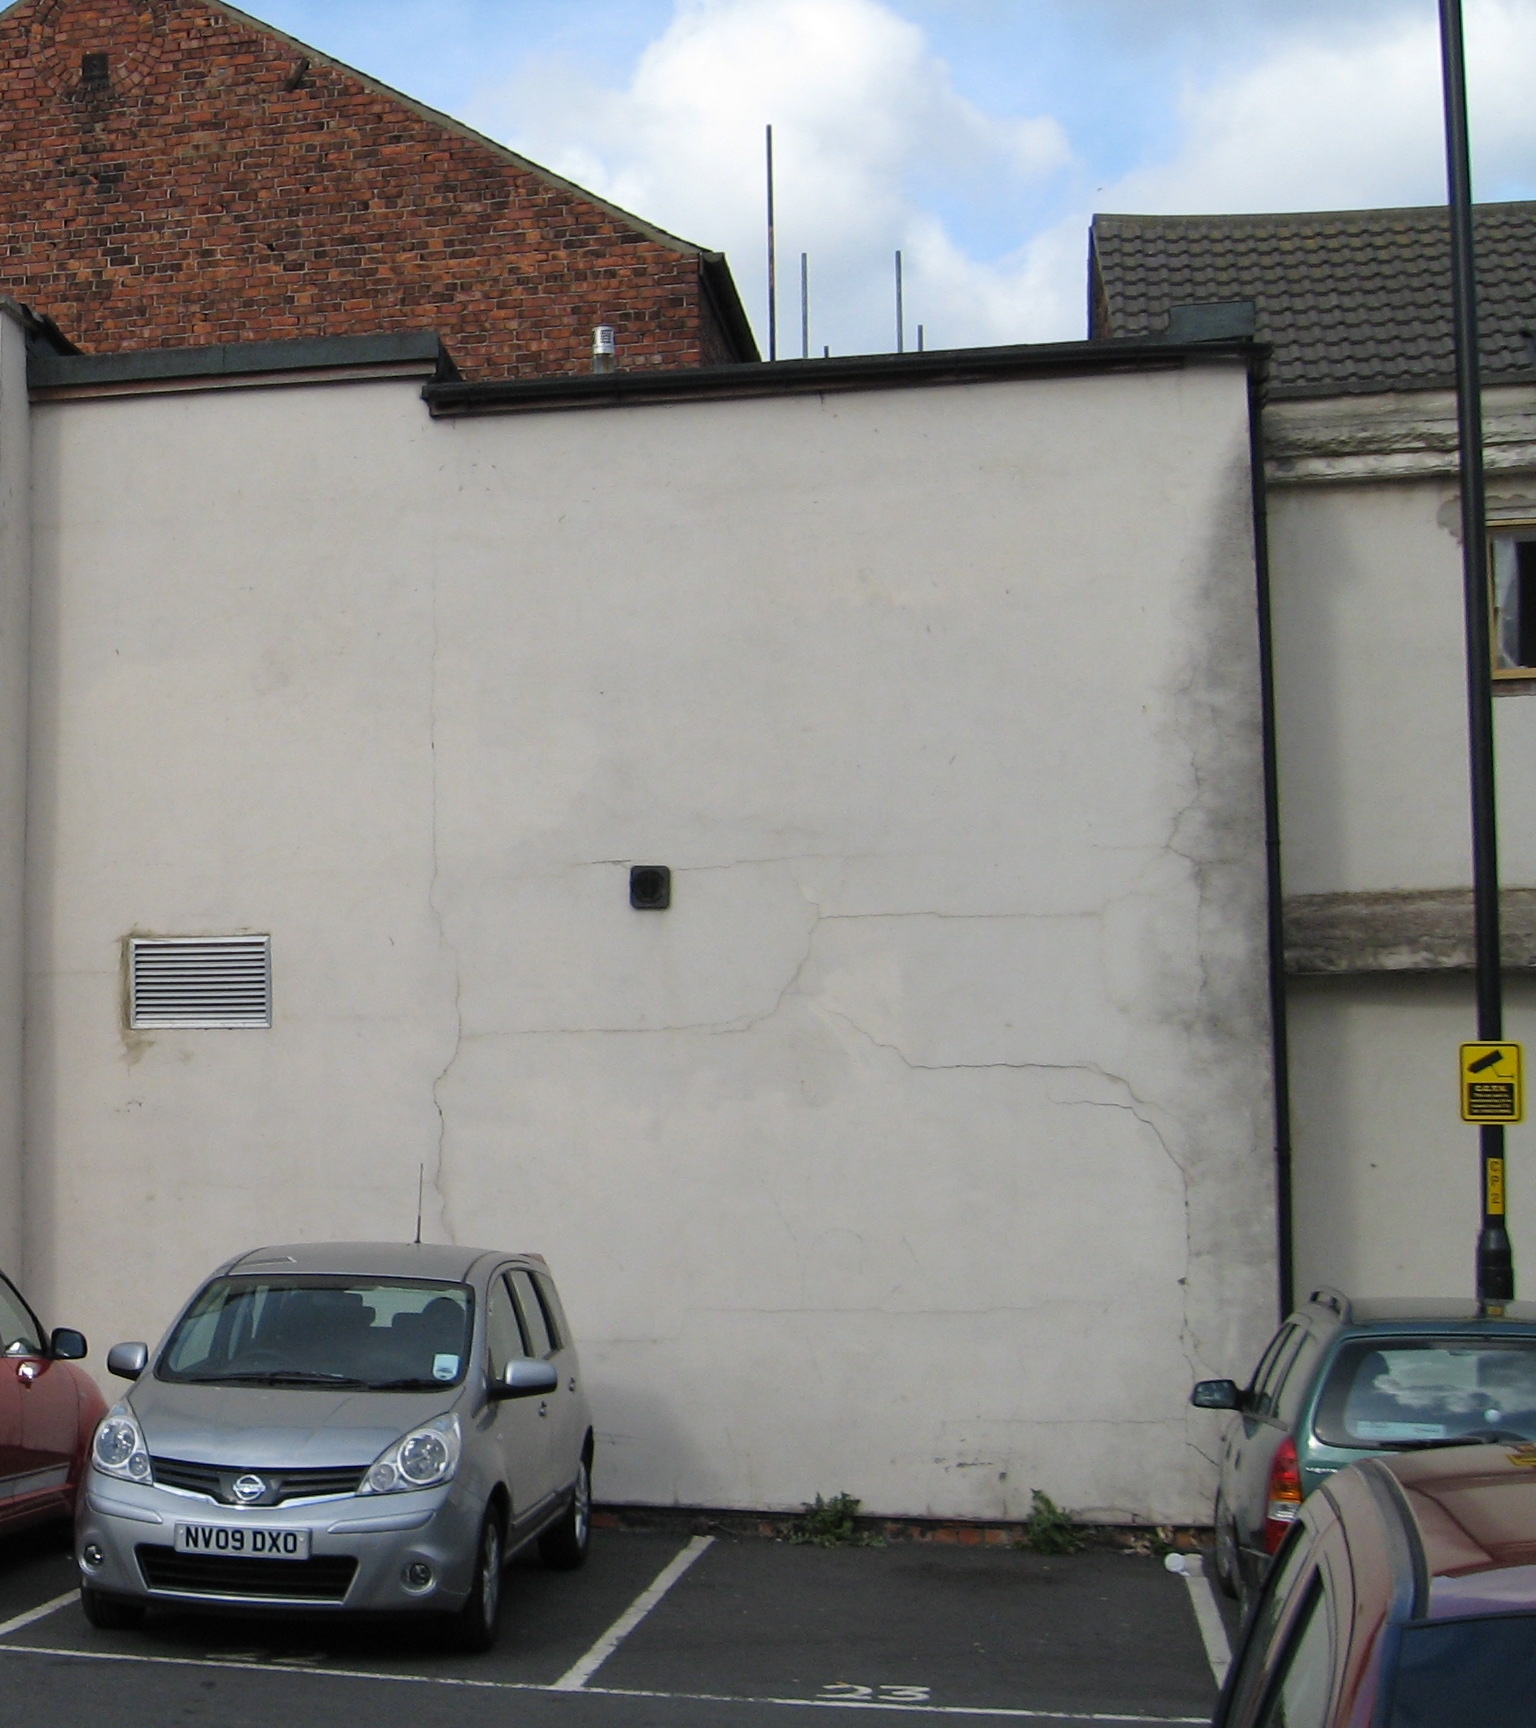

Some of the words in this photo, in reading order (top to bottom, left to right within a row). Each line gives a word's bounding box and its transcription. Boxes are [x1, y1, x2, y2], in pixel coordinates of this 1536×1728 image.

[185, 1526, 245, 1551] NV09
[252, 1530, 297, 1554] DXO
[815, 1684, 931, 1701] 23
